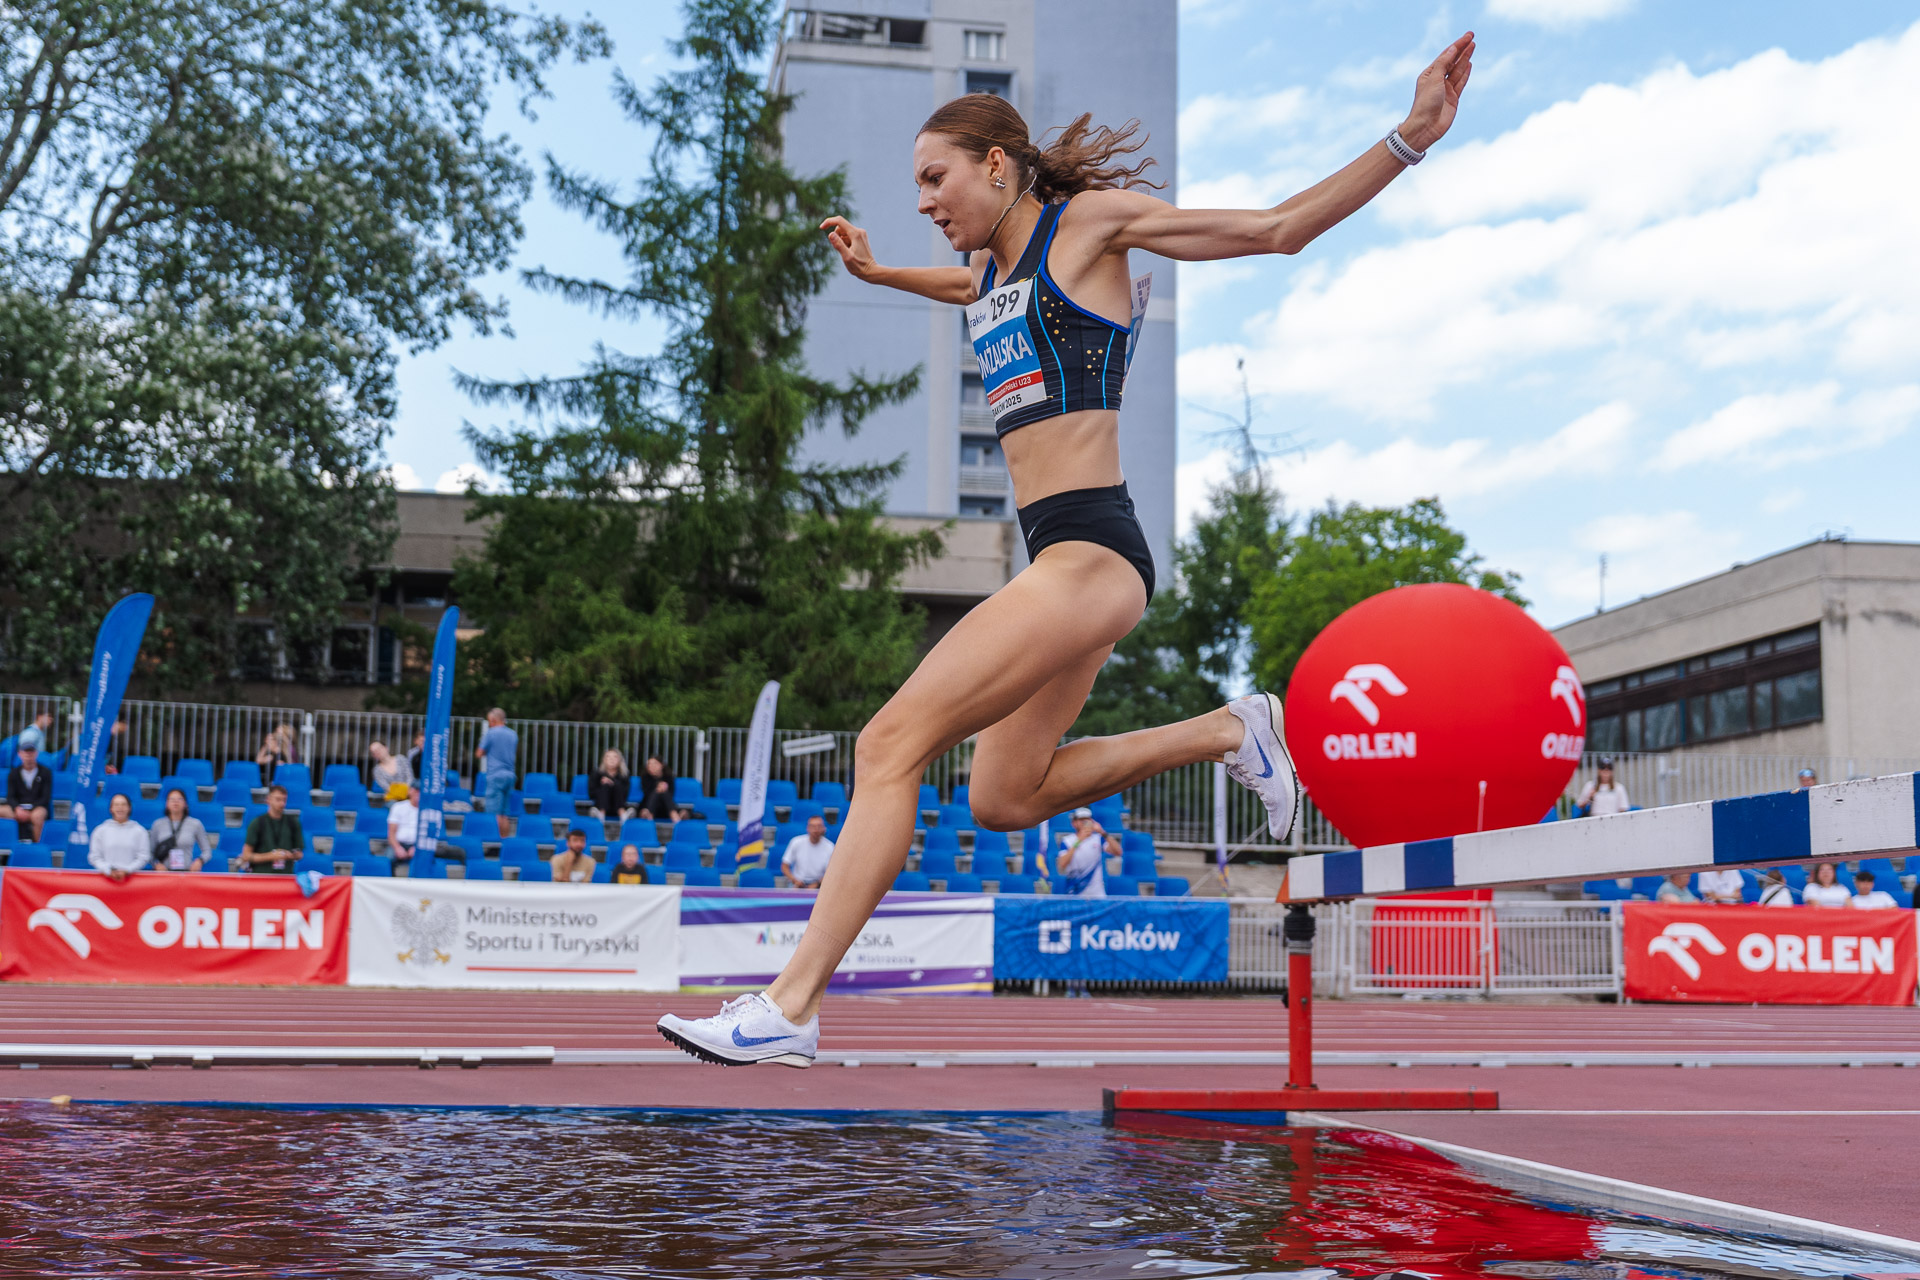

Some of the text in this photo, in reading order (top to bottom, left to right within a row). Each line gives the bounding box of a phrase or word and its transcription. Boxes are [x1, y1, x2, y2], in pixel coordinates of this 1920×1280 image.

[990, 289, 1020, 322] 299
[969, 312, 986, 329] raków
[1018, 376, 1032, 386] U23
[1005, 393, 1022, 409] 2025
[1322, 731, 1417, 761] ORLEN
[137, 905, 325, 950] ORLEN
[466, 906, 598, 928] Ministerstwo
[466, 930, 640, 957] Sportu i Turystyki
[1080, 922, 1181, 951] Kraków
[1737, 932, 1895, 975] ORLEN
